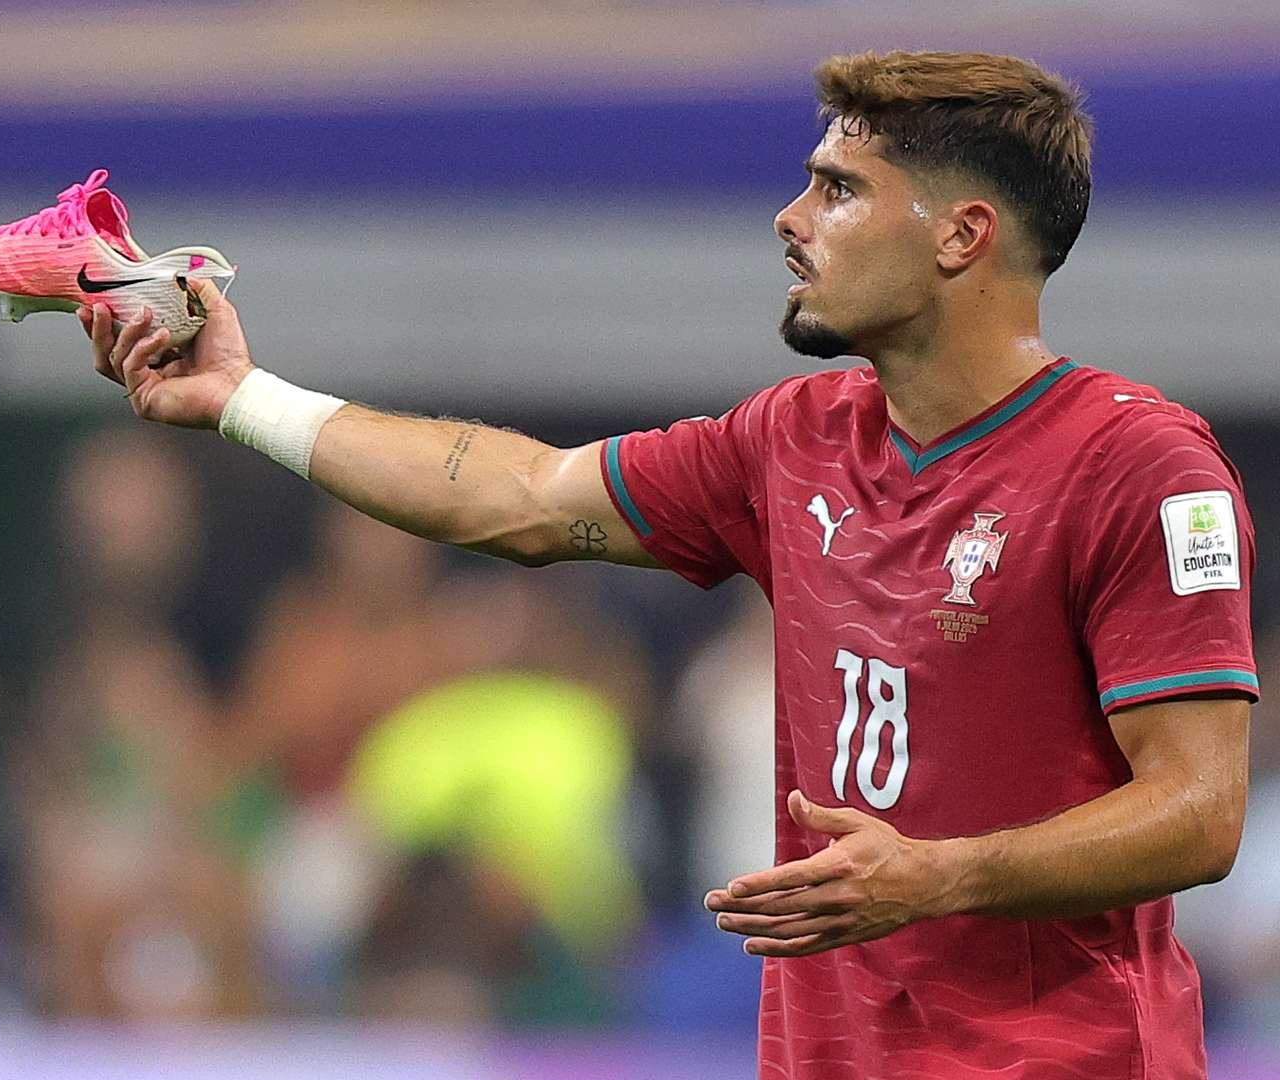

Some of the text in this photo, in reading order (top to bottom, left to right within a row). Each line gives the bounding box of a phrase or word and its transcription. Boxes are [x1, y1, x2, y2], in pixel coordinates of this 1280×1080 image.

[1183, 552, 1232, 572] EDUCATION
[1204, 570, 1223, 579] FIFA
[832, 649, 910, 810] 18
